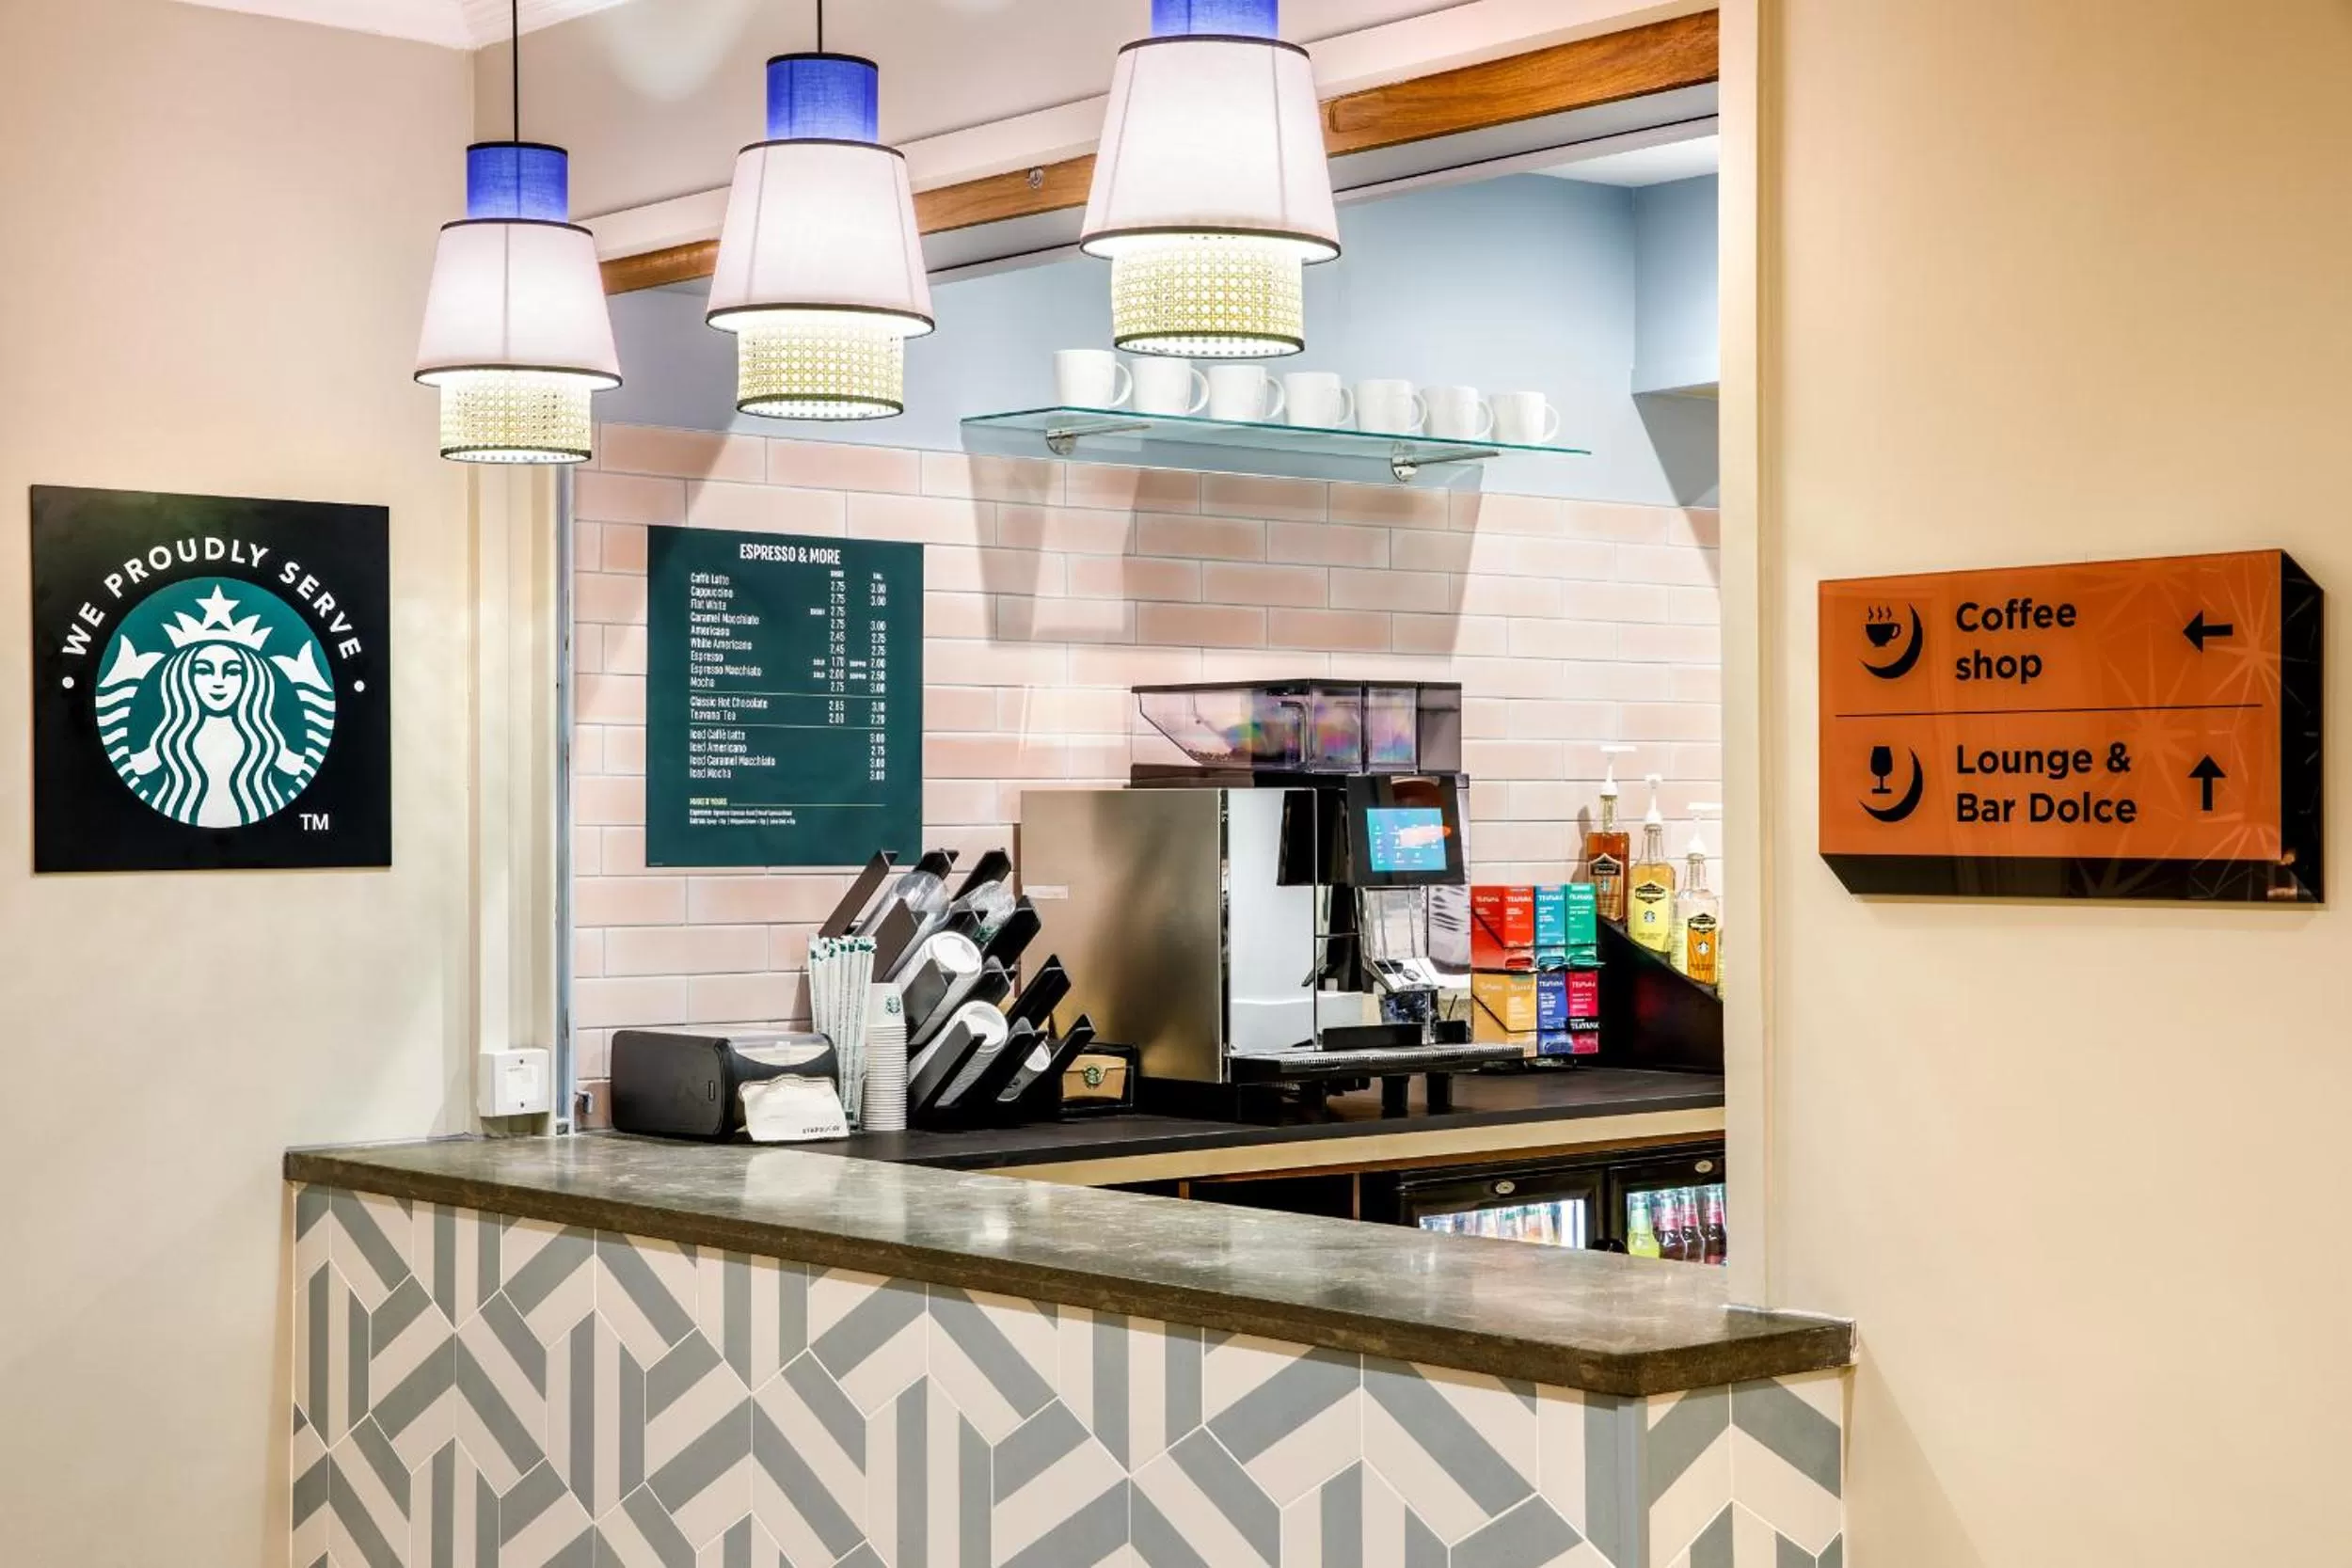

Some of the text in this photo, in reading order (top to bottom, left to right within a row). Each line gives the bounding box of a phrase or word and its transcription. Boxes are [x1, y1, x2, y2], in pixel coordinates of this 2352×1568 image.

[739, 544, 841, 564] ESPRESSO & MORE
[711, 574, 730, 585] Latte
[830, 581, 846, 593] 2.75
[870, 583, 886, 594] 3.00
[62, 537, 362, 658] WE PROUDLY SERVE
[691, 586, 886, 607] Cappuccino 2.75 3.00
[691, 598, 706, 610] Flat
[706, 600, 726, 610] White
[830, 606, 846, 617] 2.75
[1955, 598, 2076, 632] Coffee
[690, 611, 886, 631] Caramel Macchiato 2.75 3.00
[691, 626, 886, 643] Americano 2.45 2.75
[691, 638, 886, 656] White Americano 2.45 2.75
[691, 650, 723, 662] Espresso
[691, 662, 723, 674] Espresso
[723, 665, 763, 677] Macchiato
[1955, 649, 2042, 684] shop
[690, 676, 715, 688] Mocha
[830, 681, 845, 692] 2.75
[690, 696, 716, 707] Classic
[717, 697, 731, 707] Hot
[731, 697, 769, 708] Chocolate
[723, 710, 736, 721] Tea
[690, 729, 706, 739] Iced
[727, 730, 745, 740] Latte
[690, 741, 885, 756] Iced Americano 2.75
[690, 754, 706, 766] Iced
[707, 755, 738, 766] Caramel
[738, 755, 776, 766] Macchiato
[1957, 741, 2131, 780] Lounge &
[690, 767, 706, 778] Iced
[707, 768, 731, 779] Mocha
[1957, 792, 2137, 823] Bar Dolce
[300, 814, 329, 831] TM
